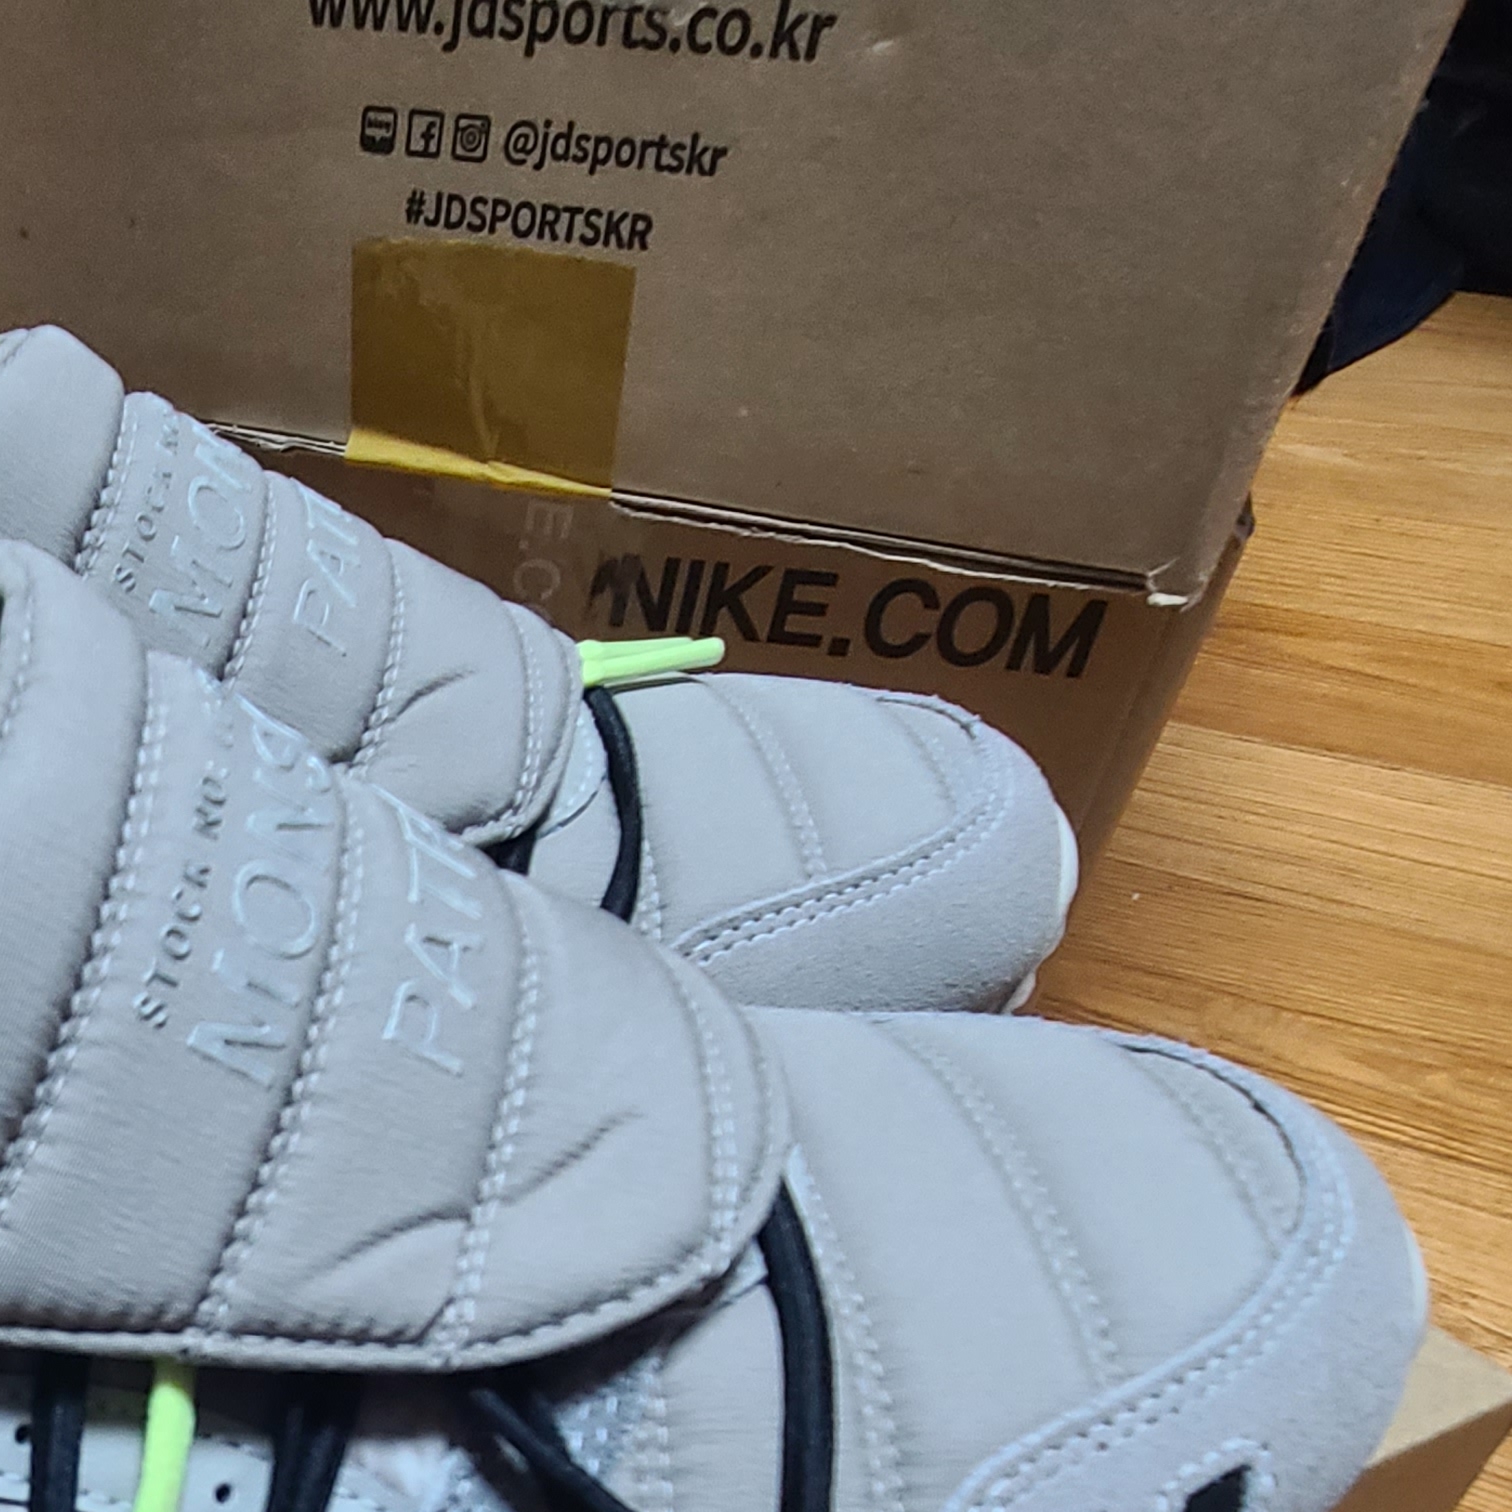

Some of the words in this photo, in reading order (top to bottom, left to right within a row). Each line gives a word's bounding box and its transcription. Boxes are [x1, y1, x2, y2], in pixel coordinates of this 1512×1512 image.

[504, 120, 728, 177] @jdsportskr
[405, 188, 654, 251] #JDSPORTSKR
[600, 553, 1109, 678] NIKE.COM
[133, 860, 212, 1030] STOCK
